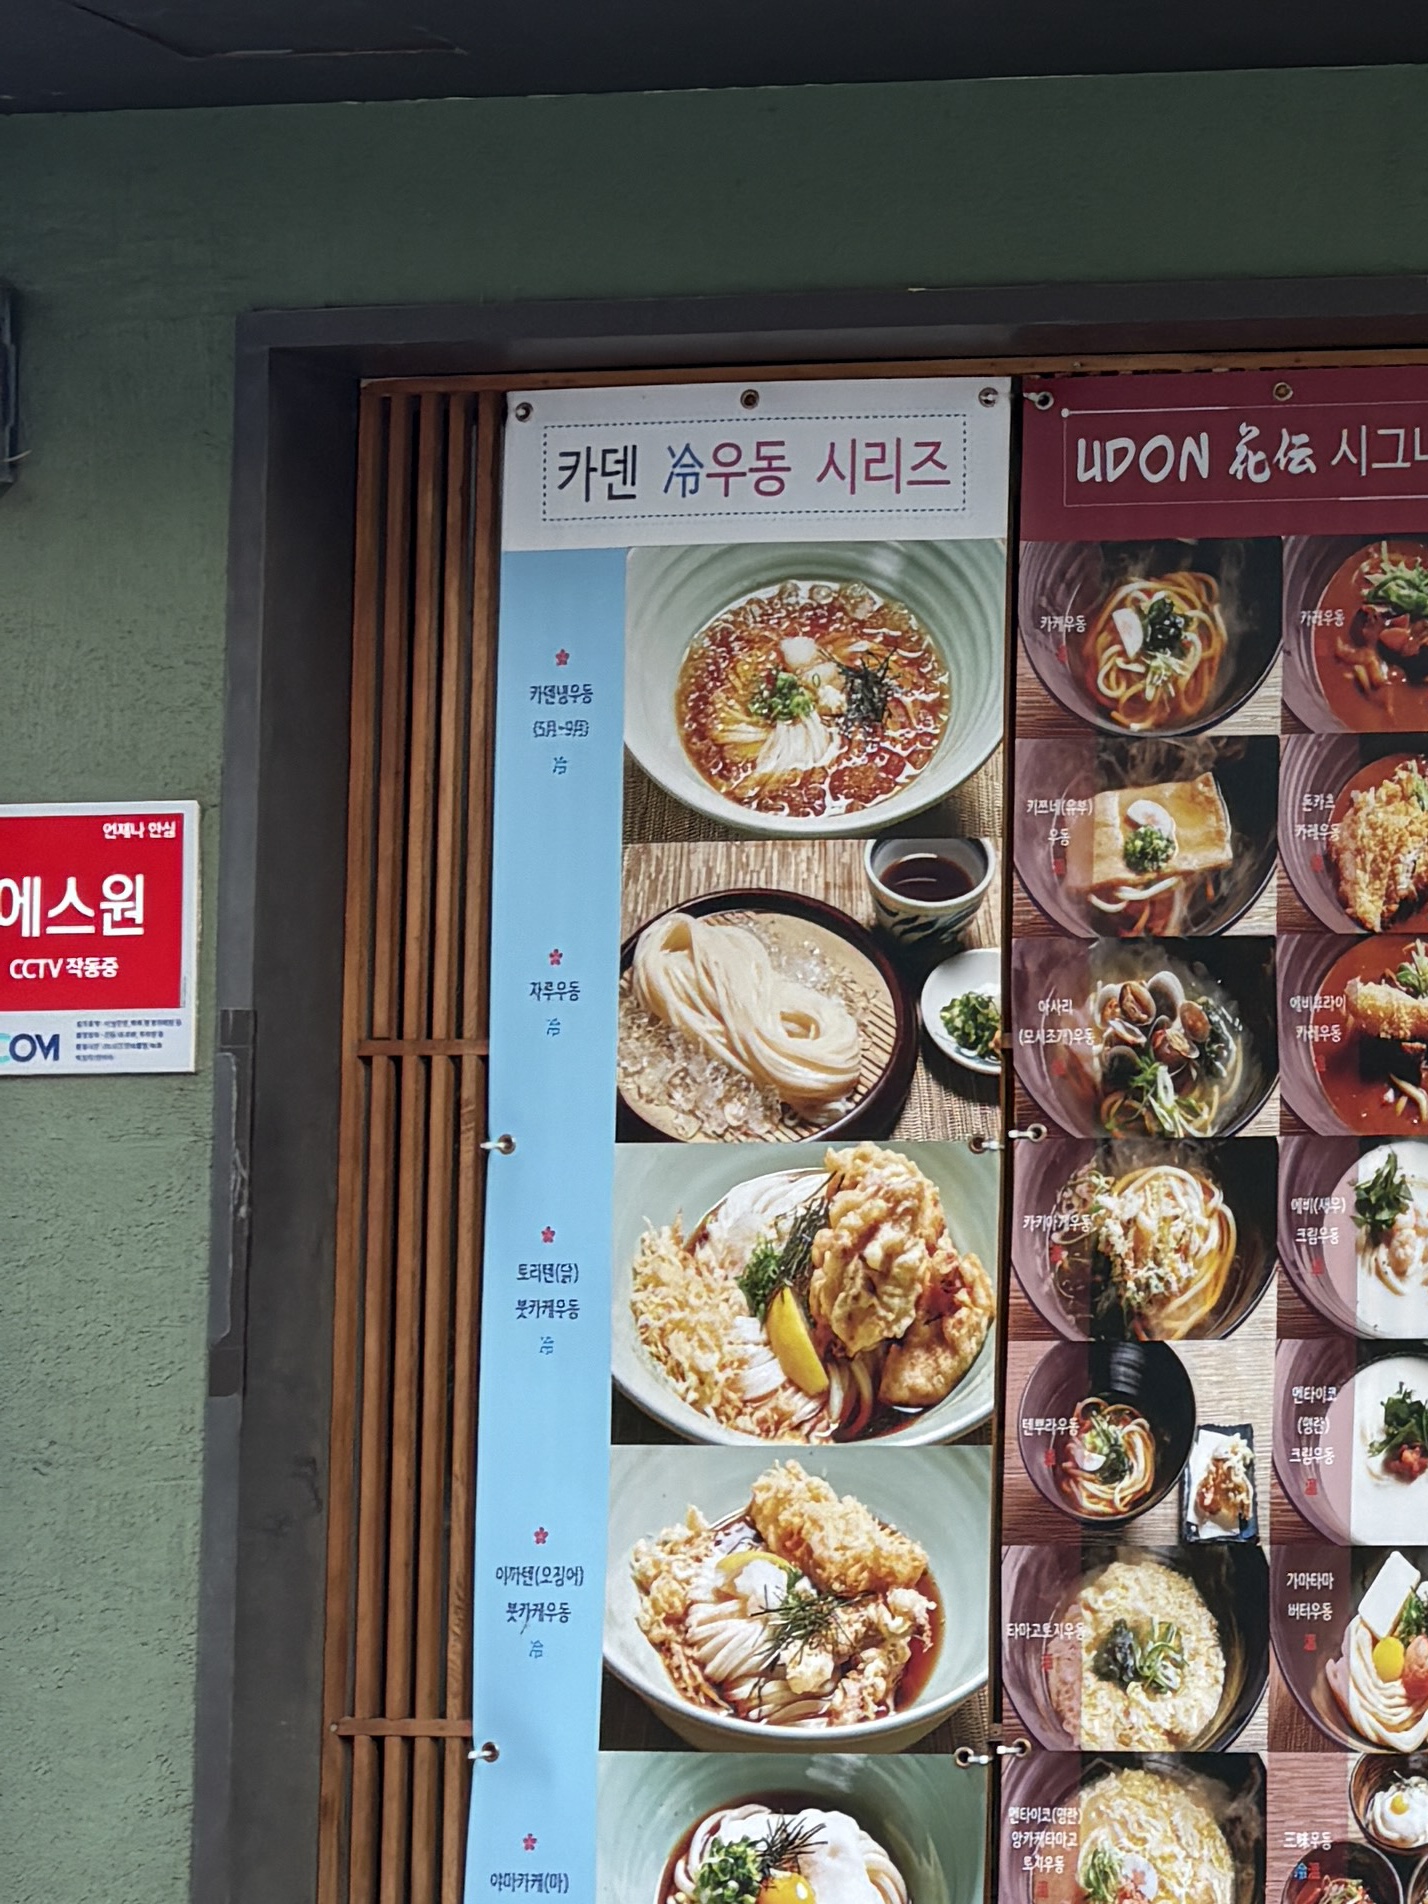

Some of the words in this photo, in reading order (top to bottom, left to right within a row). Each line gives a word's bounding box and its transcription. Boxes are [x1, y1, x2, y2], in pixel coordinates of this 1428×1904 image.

[1076, 432, 1211, 483] UDON
[557, 444, 638, 502] 카덴
[816, 436, 952, 496] 시리즈
[529, 683, 594, 705] 카덴냉우동
[102, 821, 145, 840] 언제나
[1047, 828, 1071, 846] 우동
[0, 873, 145, 938] 에스원
[9, 958, 63, 979] CCTV
[66, 956, 119, 979] 작동중
[529, 980, 581, 1002] 자루우동
[1286, 1571, 1335, 1591] 가마타마
[1287, 1602, 1334, 1622] 버터우동
